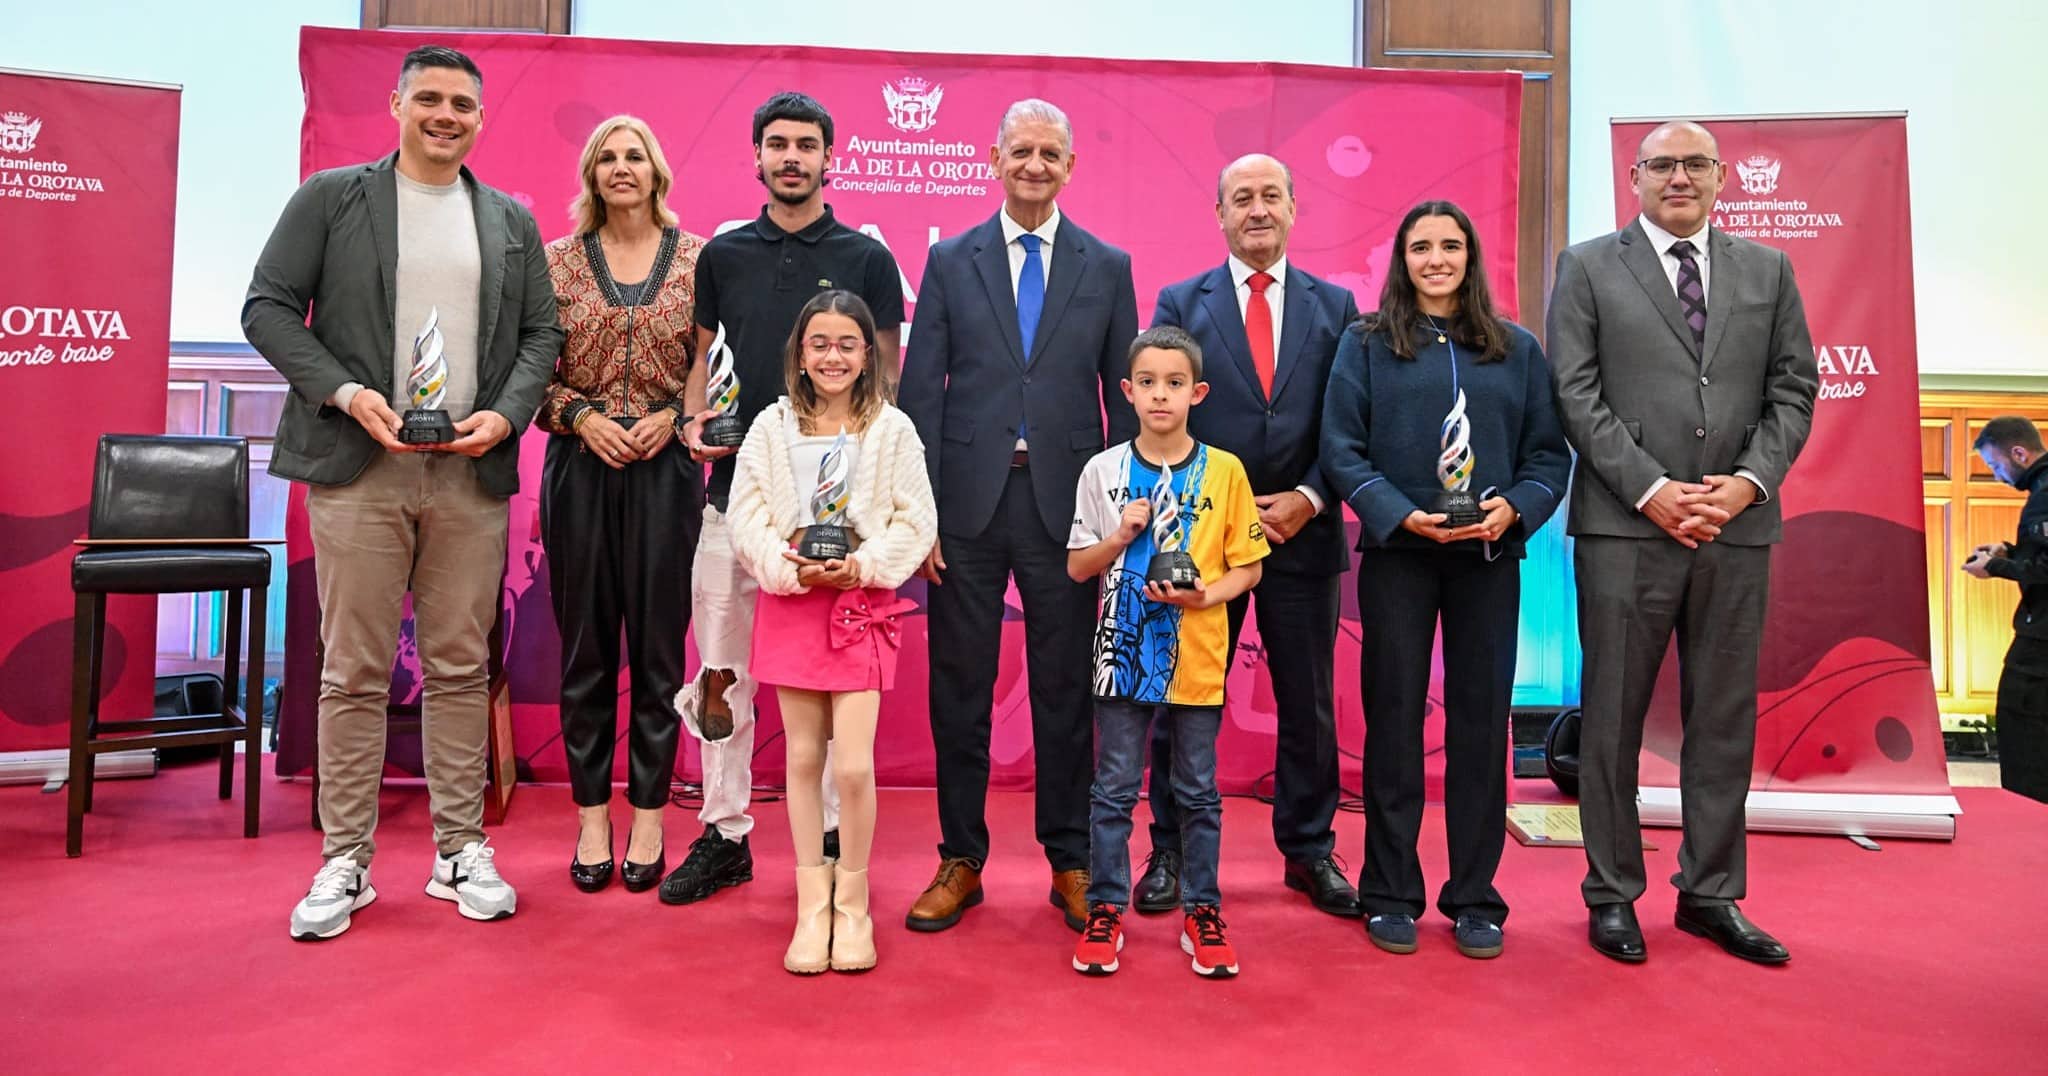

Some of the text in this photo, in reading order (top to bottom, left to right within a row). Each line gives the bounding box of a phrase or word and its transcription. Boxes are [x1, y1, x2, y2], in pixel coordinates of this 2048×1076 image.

[847, 135, 976, 157] Ayuntamiento
[0, 156, 68, 173] tamiento
[866, 158, 893, 176] DE
[896, 160, 924, 178] LA
[928, 162, 997, 181] OROTA
[1, 171, 105, 192] LA OROTAVA
[832, 177, 987, 197] Concejalía de Deportes
[8, 187, 23, 198] de
[25, 188, 77, 201] Deportes
[1713, 198, 1808, 213] Ayuntamiento
[1728, 213, 1749, 227] DE
[1752, 213, 1772, 227] LA
[1774, 213, 1843, 228] OROTAVA
[1759, 228, 1771, 238] de
[1773, 228, 1819, 240] Deportes
[0, 305, 131, 340] OTAVA
[61, 342, 115, 364] base
[1818, 379, 1867, 401] base
